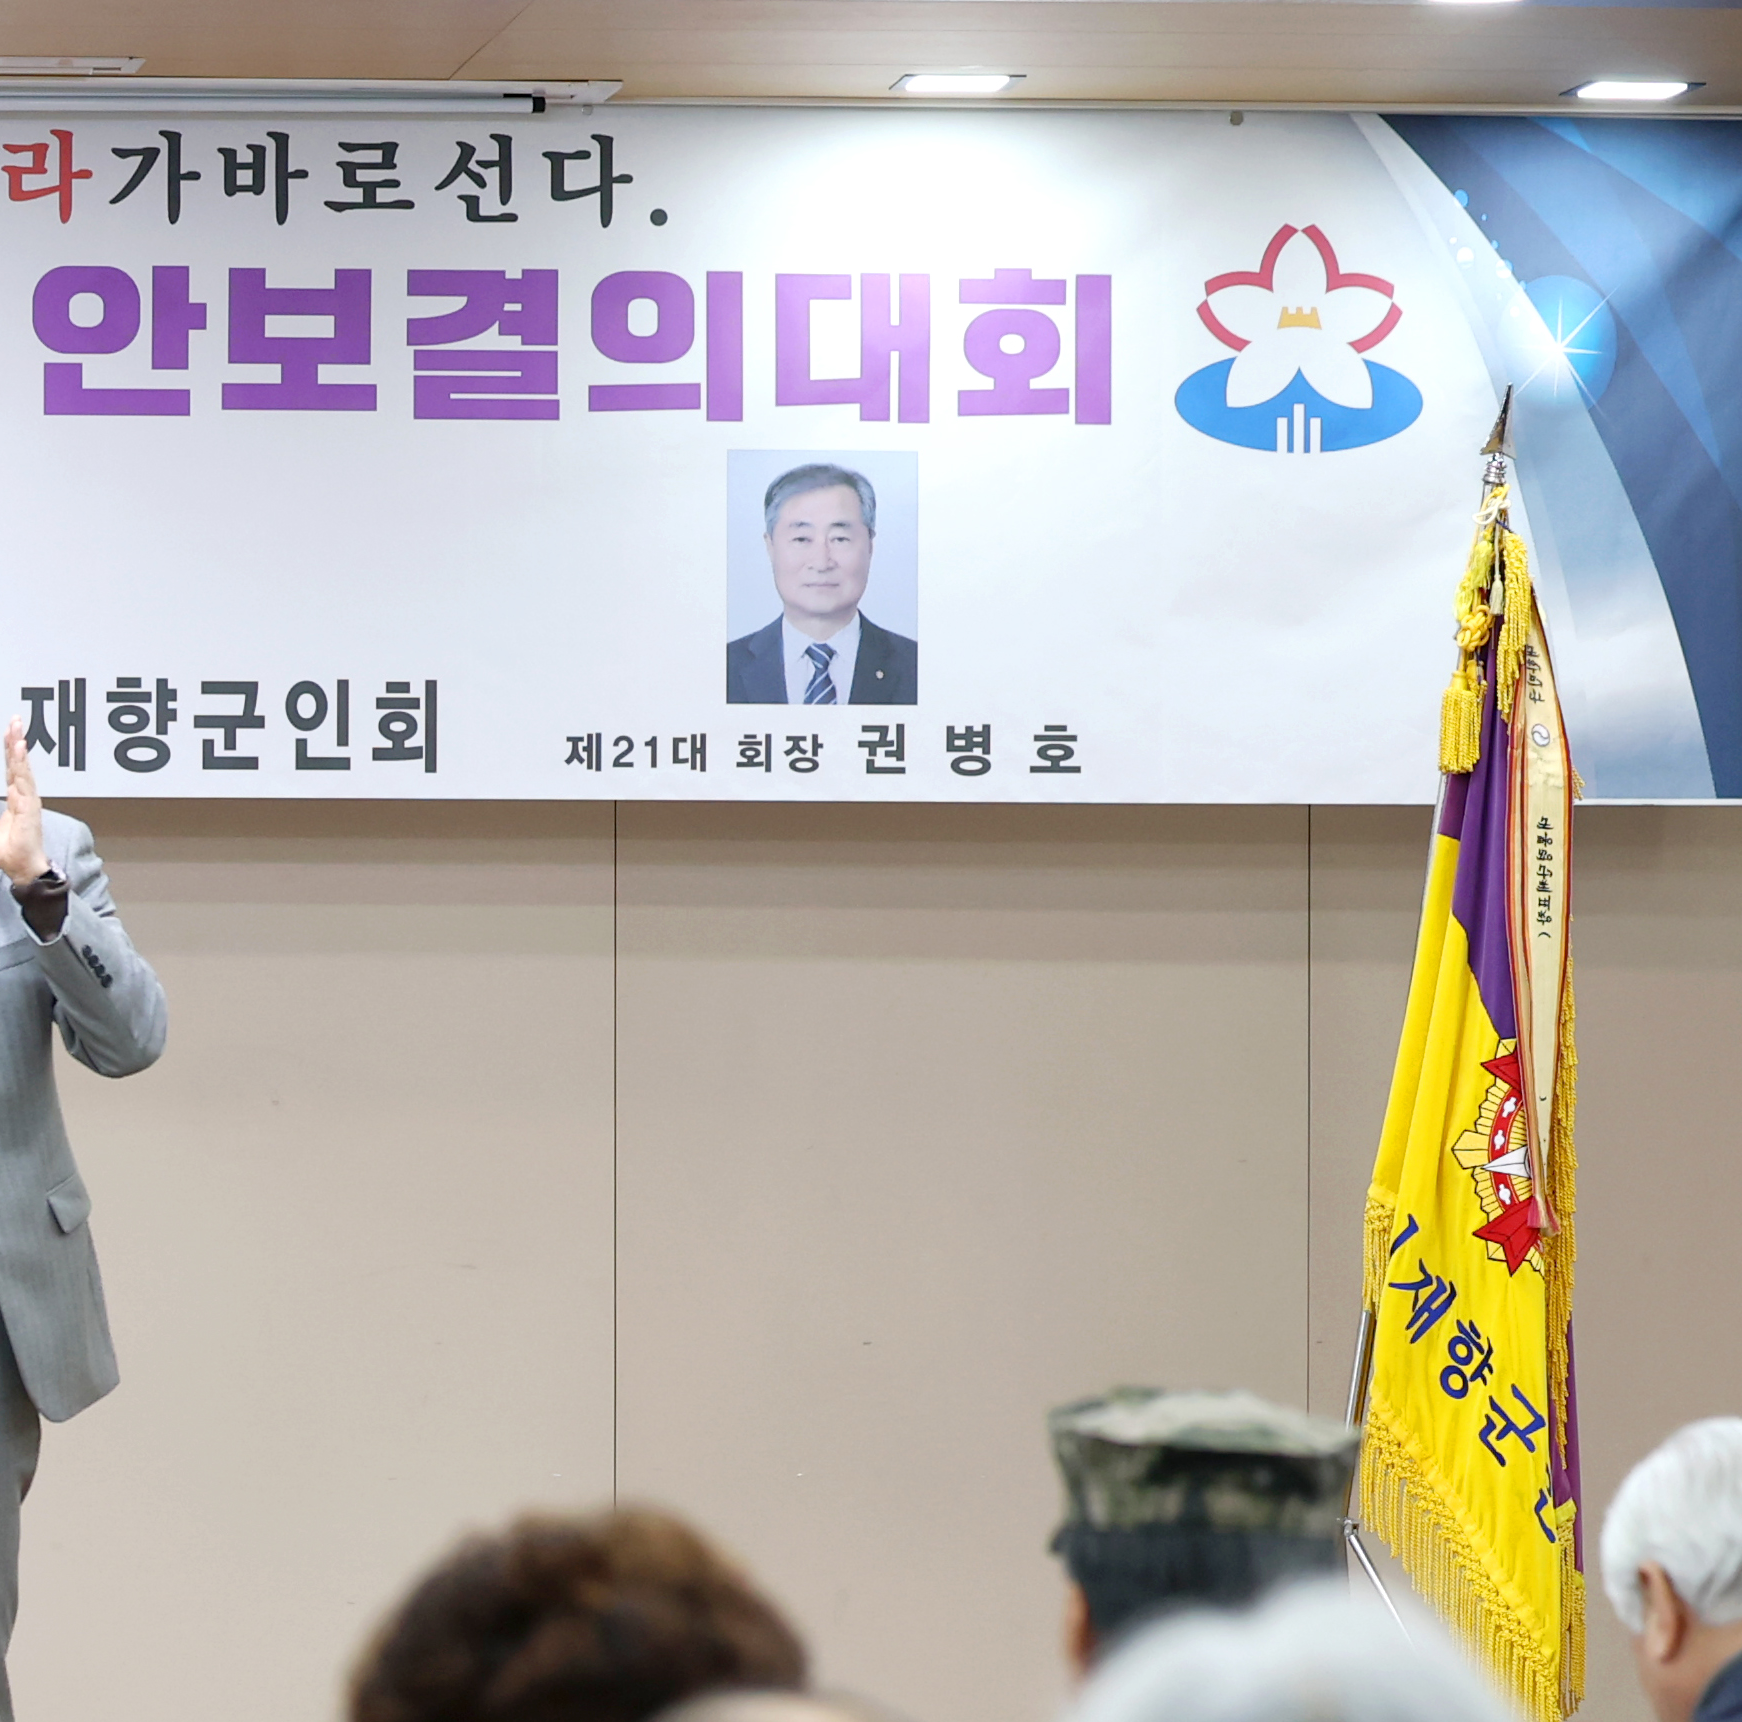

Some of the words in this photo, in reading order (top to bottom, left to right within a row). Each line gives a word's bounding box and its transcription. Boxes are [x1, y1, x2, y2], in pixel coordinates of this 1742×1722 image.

[31, 265, 1113, 426] 안보결의대회
[20, 677, 439, 775] 재향군인회
[565, 733, 708, 774] 제21대
[736, 734, 825, 775] 회장
